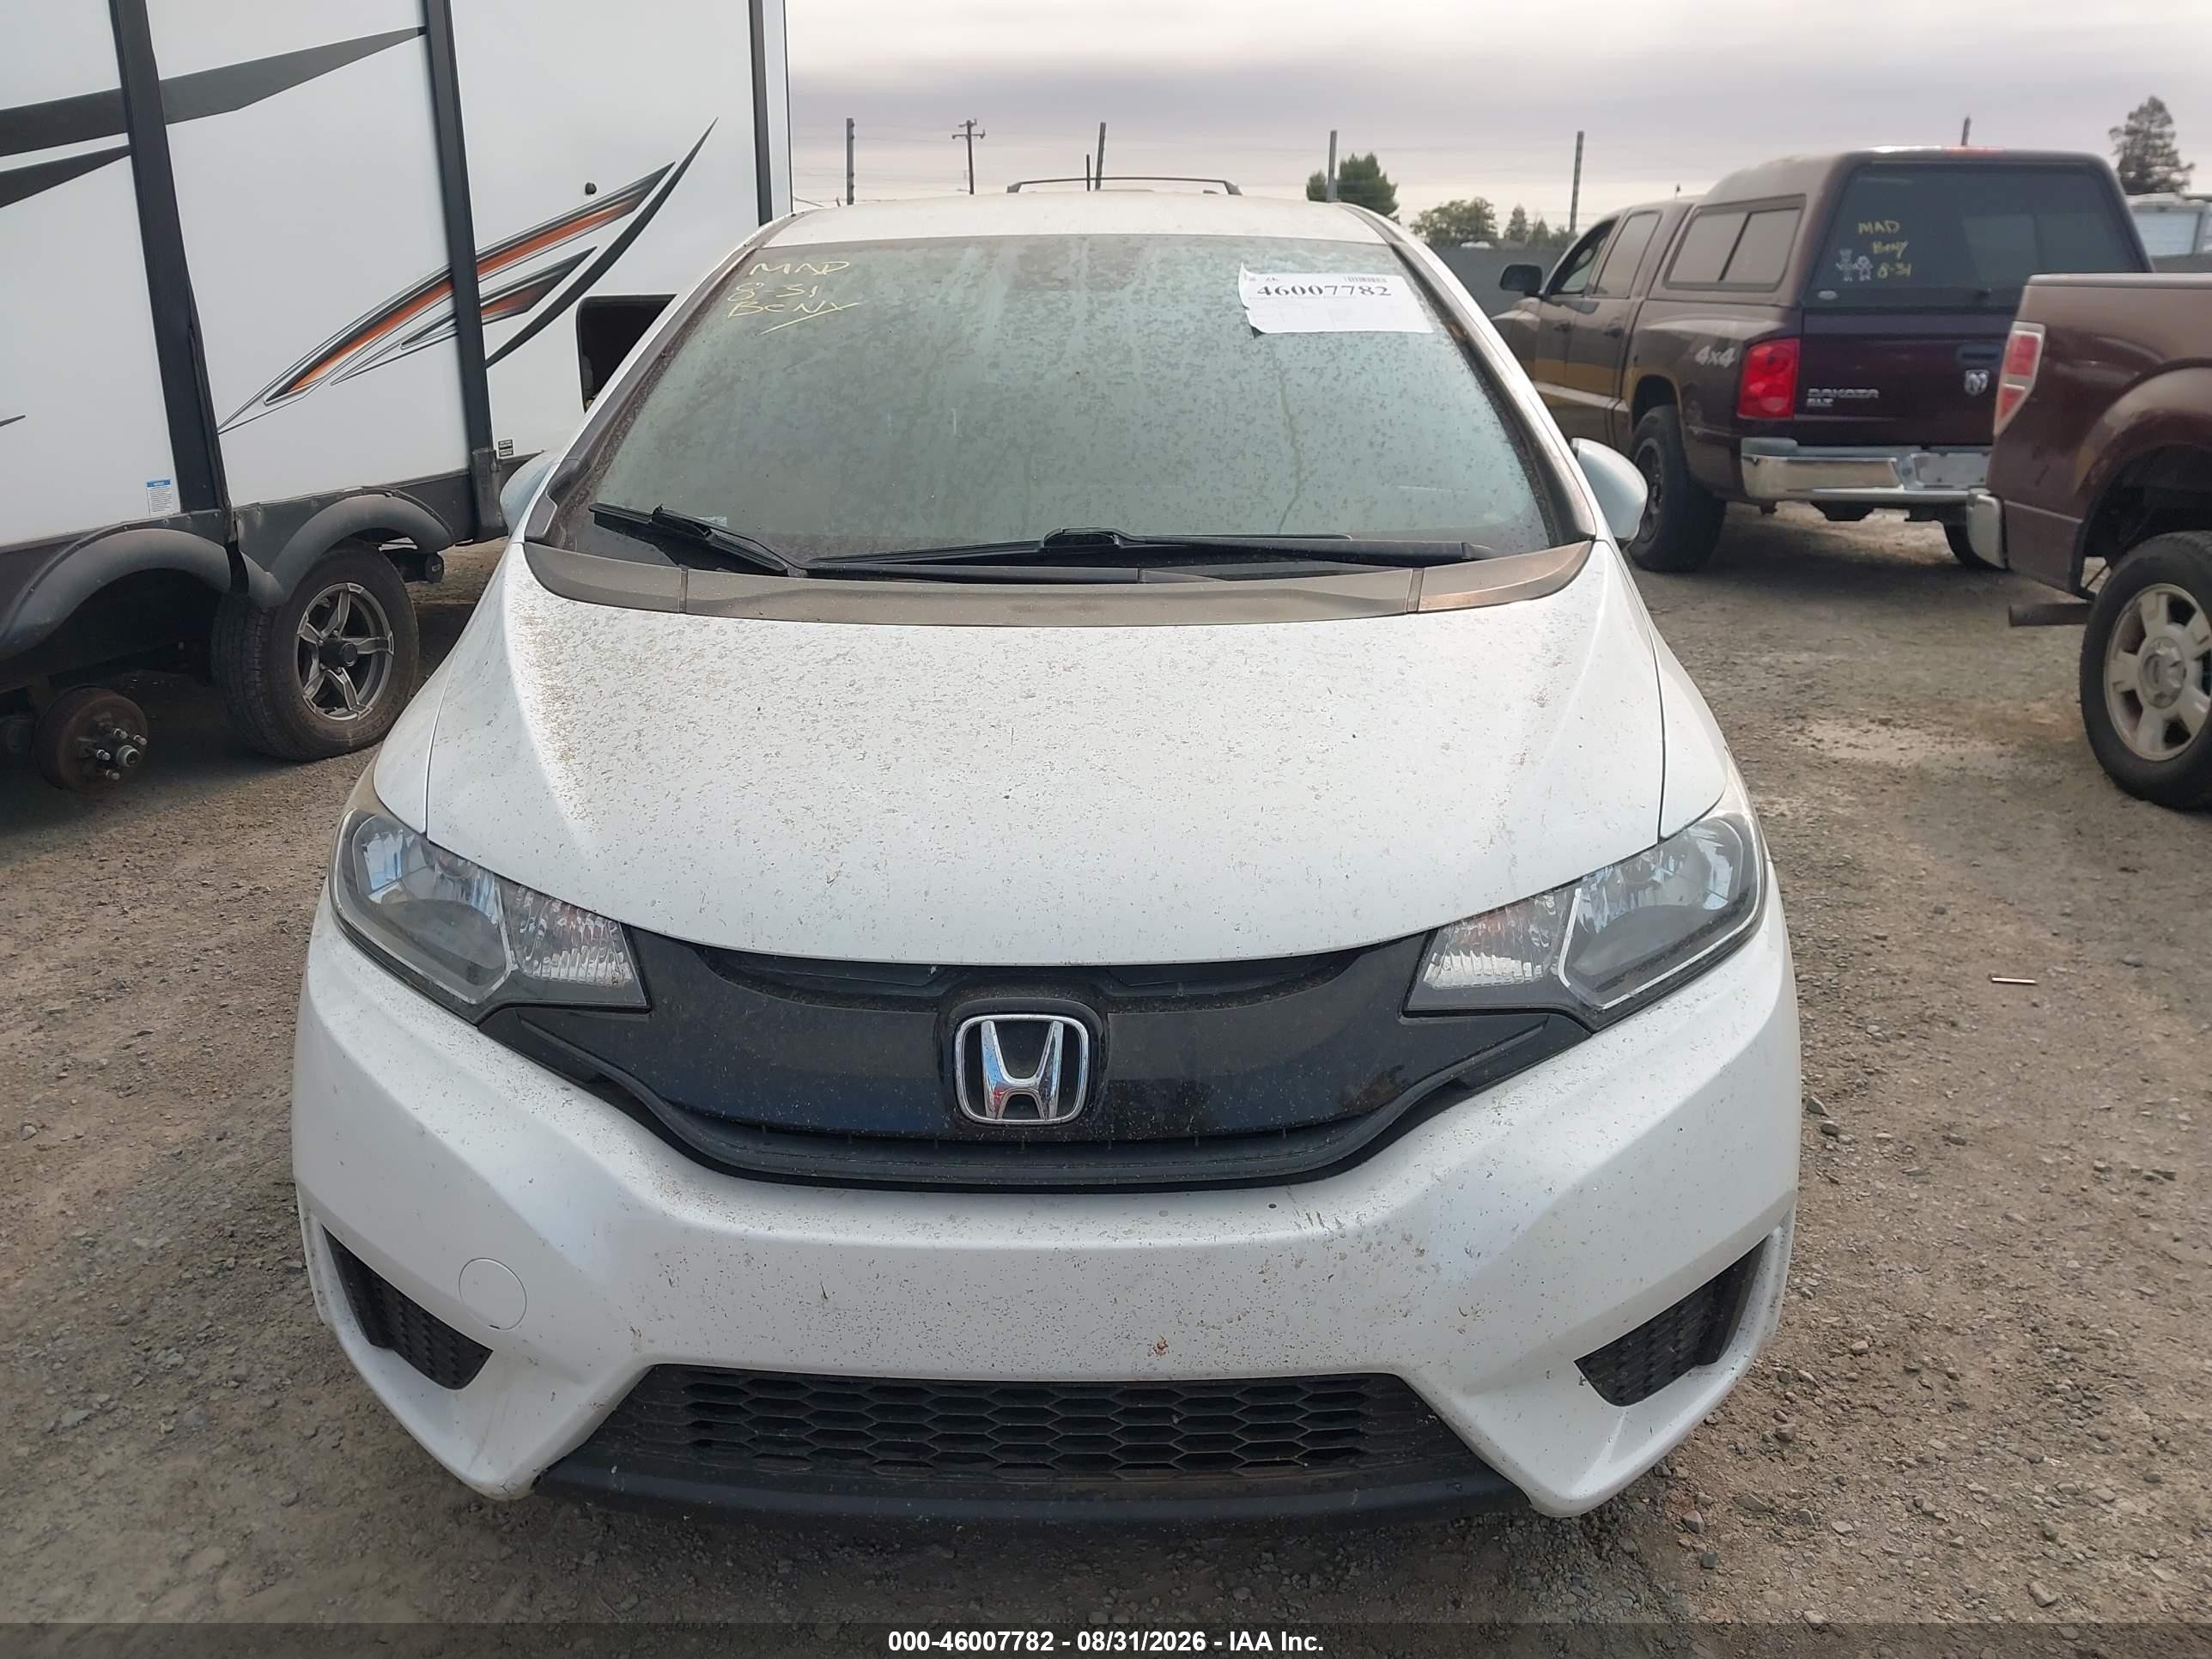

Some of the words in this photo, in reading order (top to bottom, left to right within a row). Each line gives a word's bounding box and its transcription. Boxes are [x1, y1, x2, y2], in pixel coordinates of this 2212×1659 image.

[1858, 220, 1900, 234] MAD
[750, 261, 850, 276] MAD
[1257, 285, 1392, 295] 46007782
[1695, 345, 1735, 368] 4x4
